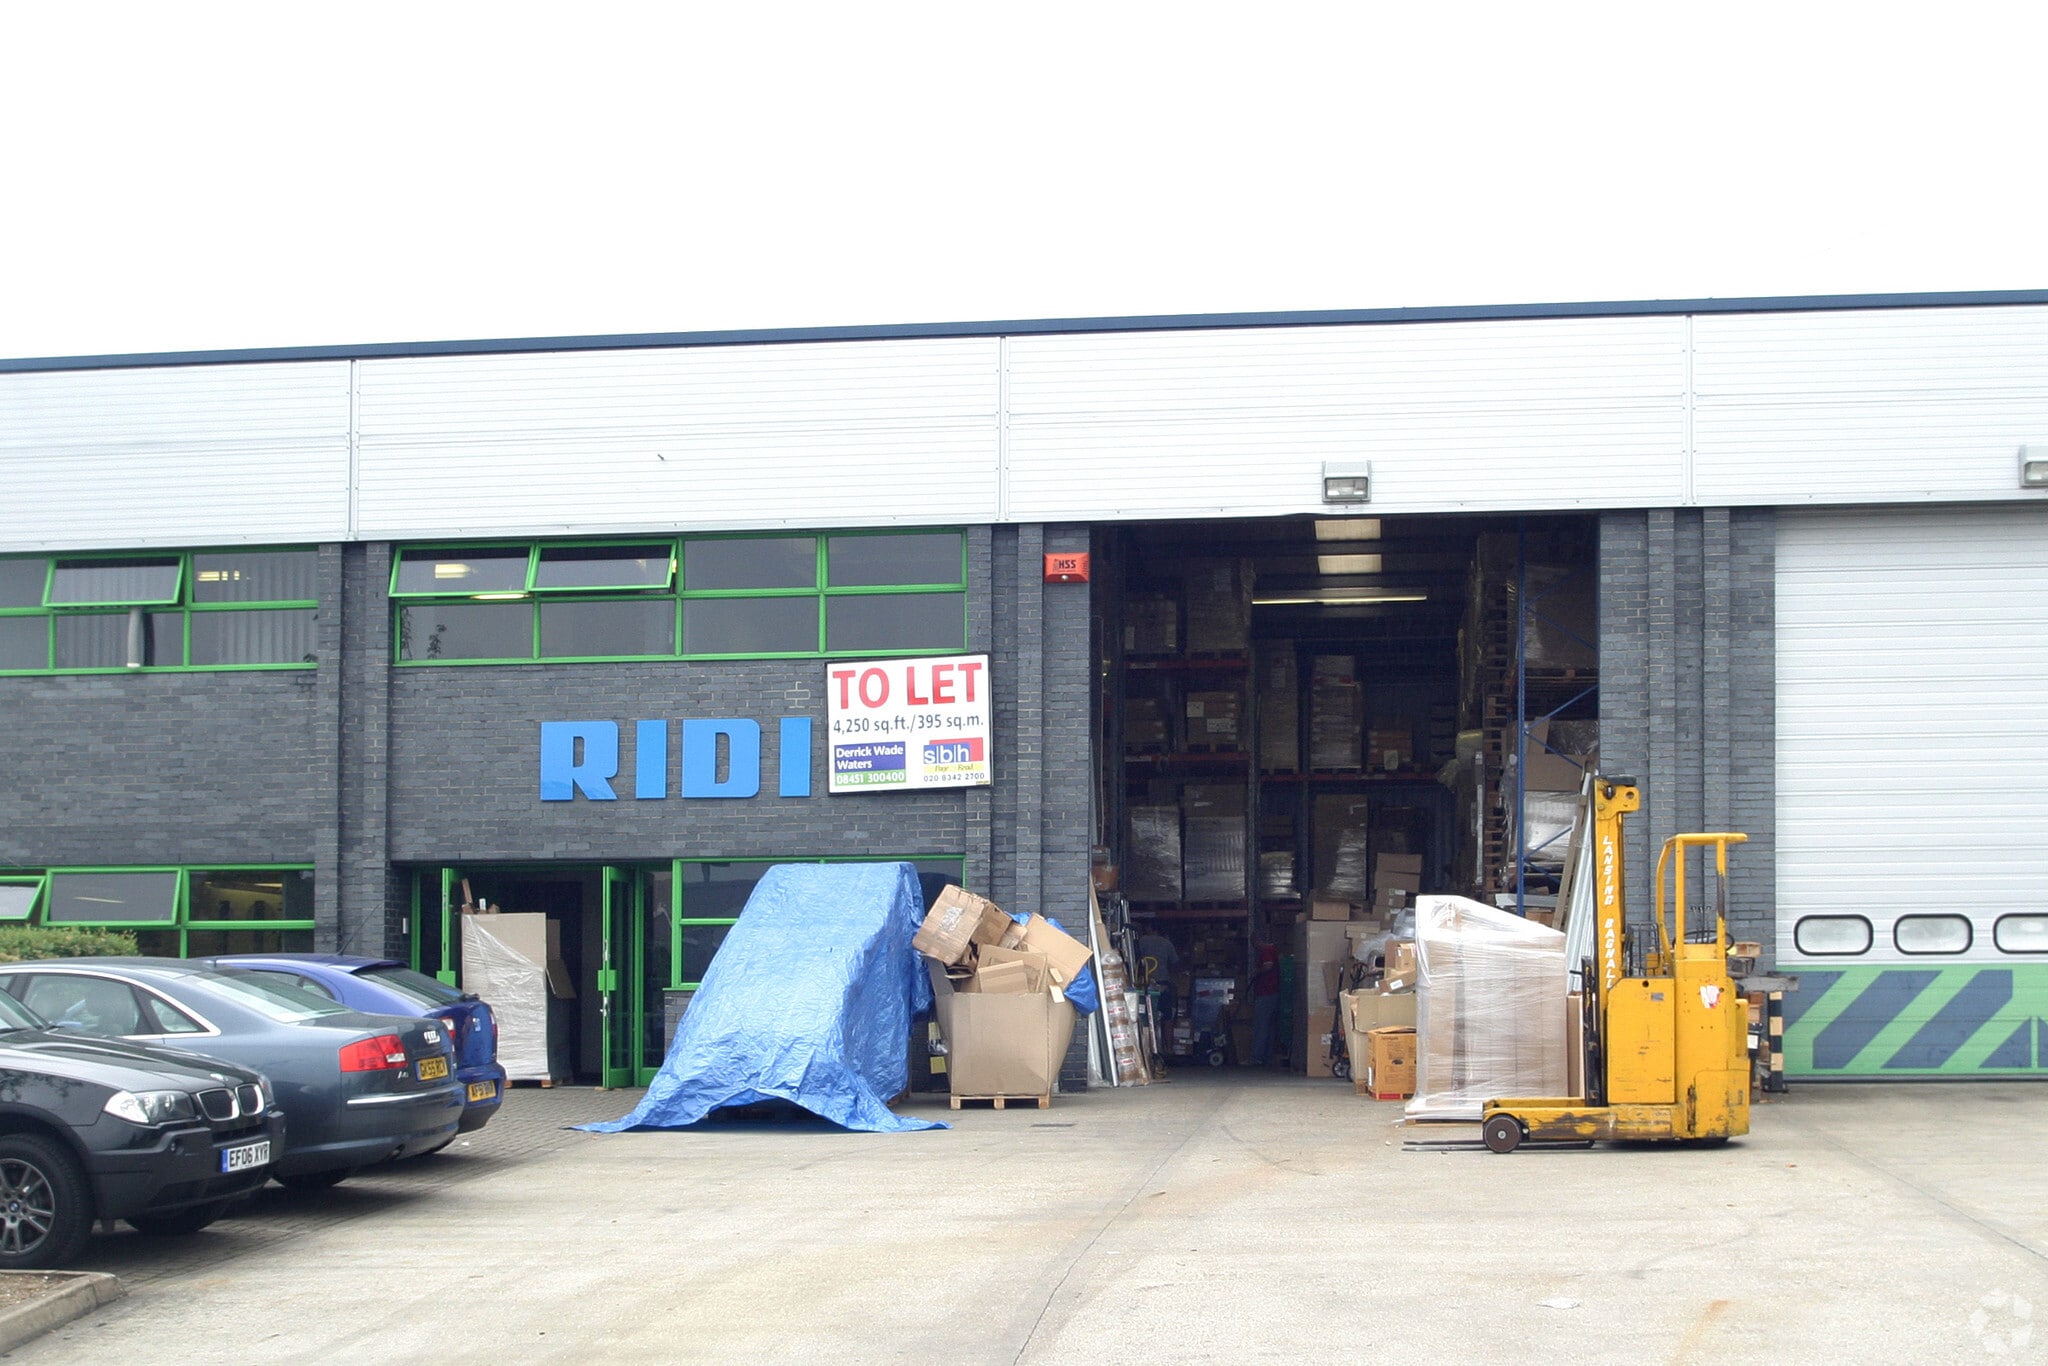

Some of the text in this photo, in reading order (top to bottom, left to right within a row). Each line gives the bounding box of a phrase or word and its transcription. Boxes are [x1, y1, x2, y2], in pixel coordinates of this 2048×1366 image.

[1058, 560, 1076, 569] HSS
[832, 662, 982, 709] TO LET
[833, 717, 870, 735] 4,250
[946, 714, 984, 731] sq.m.
[540, 717, 812, 801] RIDI
[836, 744, 904, 759] Derrick Wade
[836, 760, 873, 770] Waters
[836, 771, 905, 785] 08451 300400
[923, 775, 939, 783] 020
[965, 772, 985, 781] 2700
[1602, 835, 1614, 906] LANSING
[1604, 918, 1616, 989] BAGNALL
[229, 1147, 253, 1168] EF06
